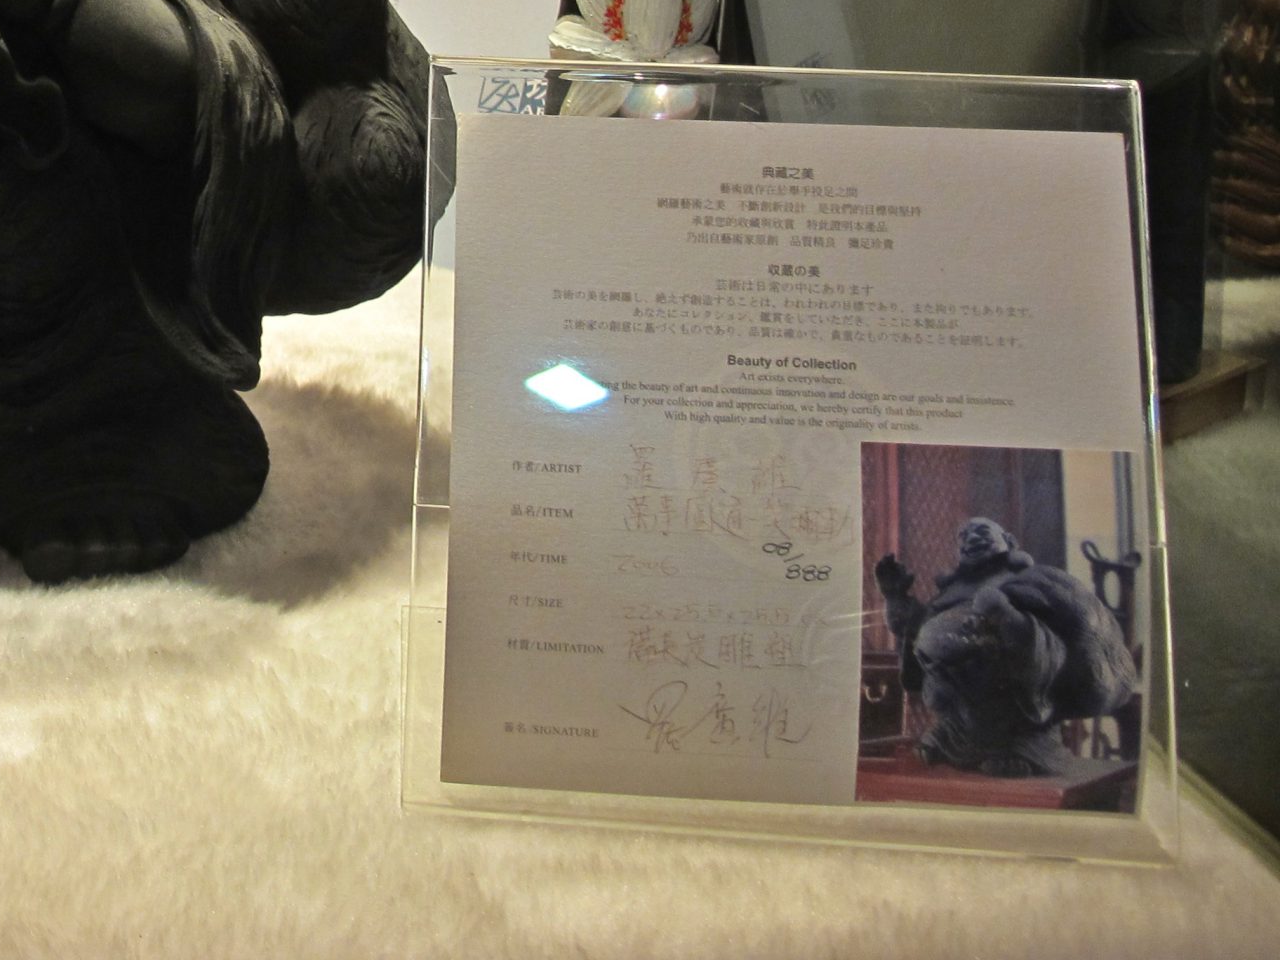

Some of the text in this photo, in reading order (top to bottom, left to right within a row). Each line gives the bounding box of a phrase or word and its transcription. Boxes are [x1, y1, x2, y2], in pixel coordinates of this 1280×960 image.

[761, 165, 815, 180] 典藏之美
[727, 354, 857, 371] Beauty of Collection
[739, 372, 845, 386] Art exists everywhere.
[622, 379, 638, 390] the
[639, 380, 670, 393] beauty
[673, 382, 686, 392] of
[686, 384, 699, 393] art
[701, 384, 719, 394] and
[721, 385, 773, 396] continuous
[776, 386, 825, 398] innovation
[828, 390, 846, 400] and
[848, 390, 879, 403] design
[882, 393, 897, 401] are
[899, 393, 915, 402] our
[918, 394, 944, 405] goals
[946, 394, 963, 404] and
[624, 394, 963, 419] For your collection and appreciation, we hereby certify that this product
[664, 410, 688, 422] With
[690, 411, 711, 424] high
[714, 413, 746, 426] quality
[749, 414, 767, 424] and
[769, 415, 795, 425] value
[808, 416, 823, 427] the
[825, 418, 875, 431] originality
[877, 419, 889, 429] of
